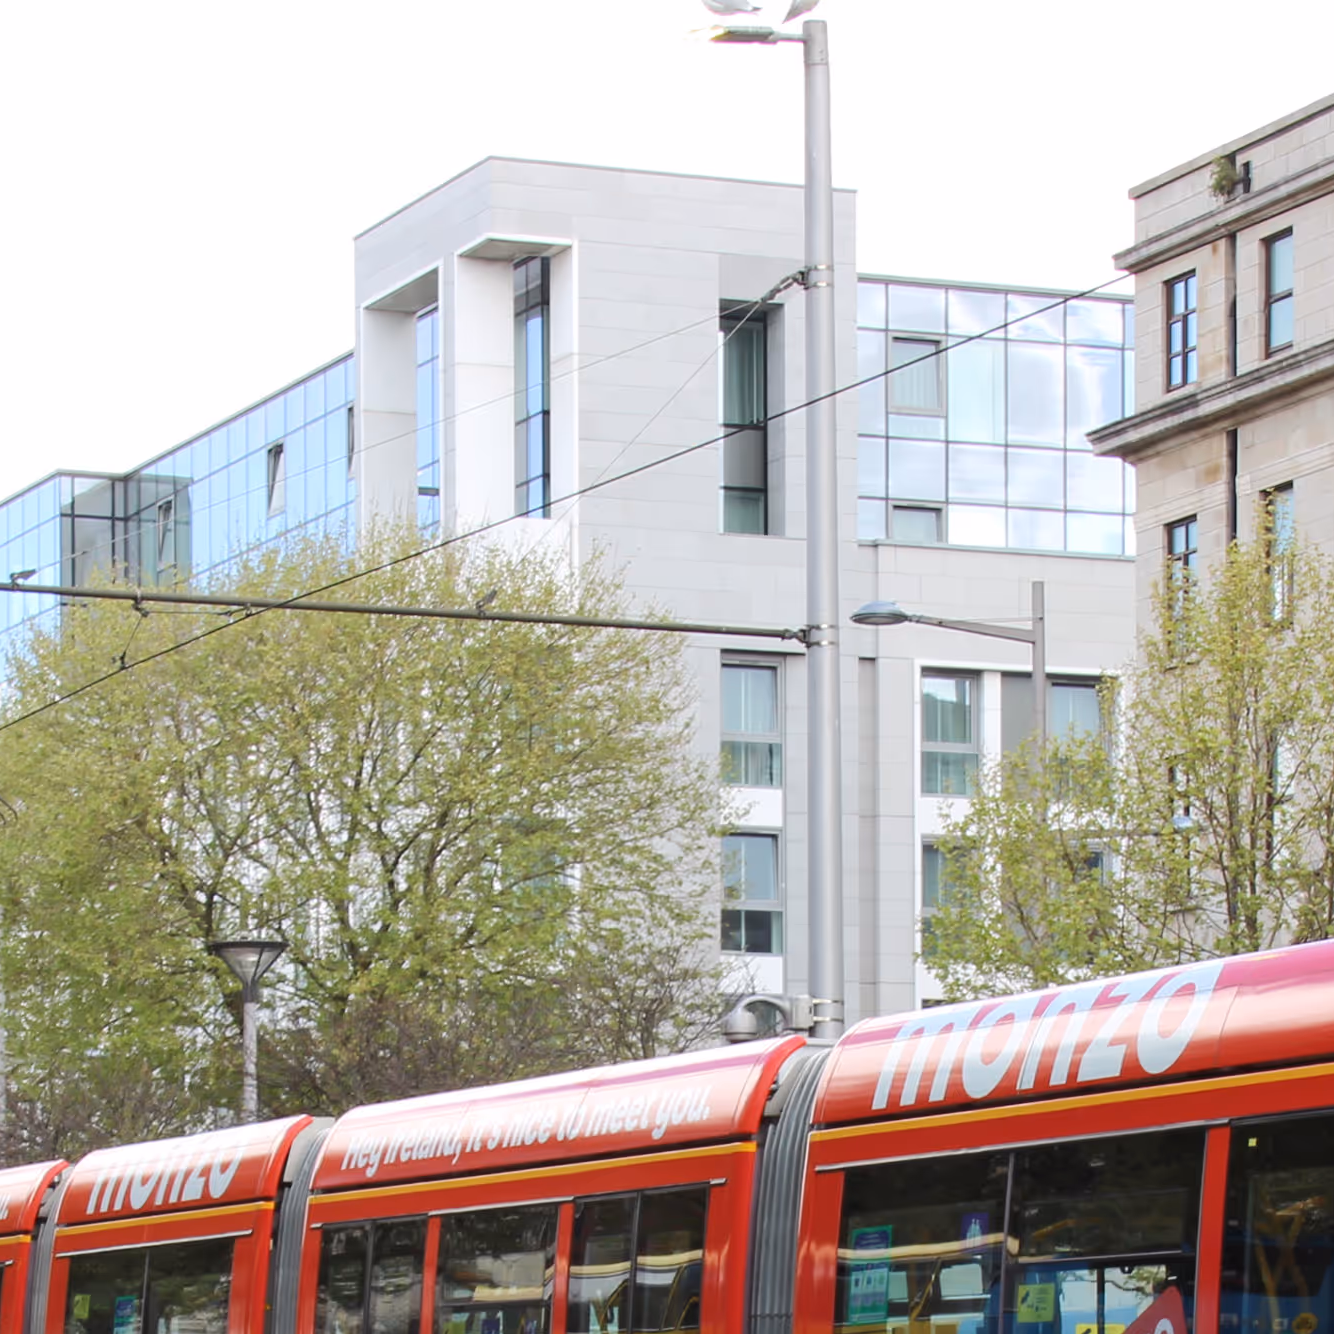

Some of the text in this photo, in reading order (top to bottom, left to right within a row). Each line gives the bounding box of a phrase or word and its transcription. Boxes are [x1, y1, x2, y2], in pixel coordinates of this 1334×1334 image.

[871, 962, 1224, 1110] monzo
[341, 1086, 712, 1177] Hey Ireland, it's nice to meet you.
[86, 1145, 247, 1215] monzo
